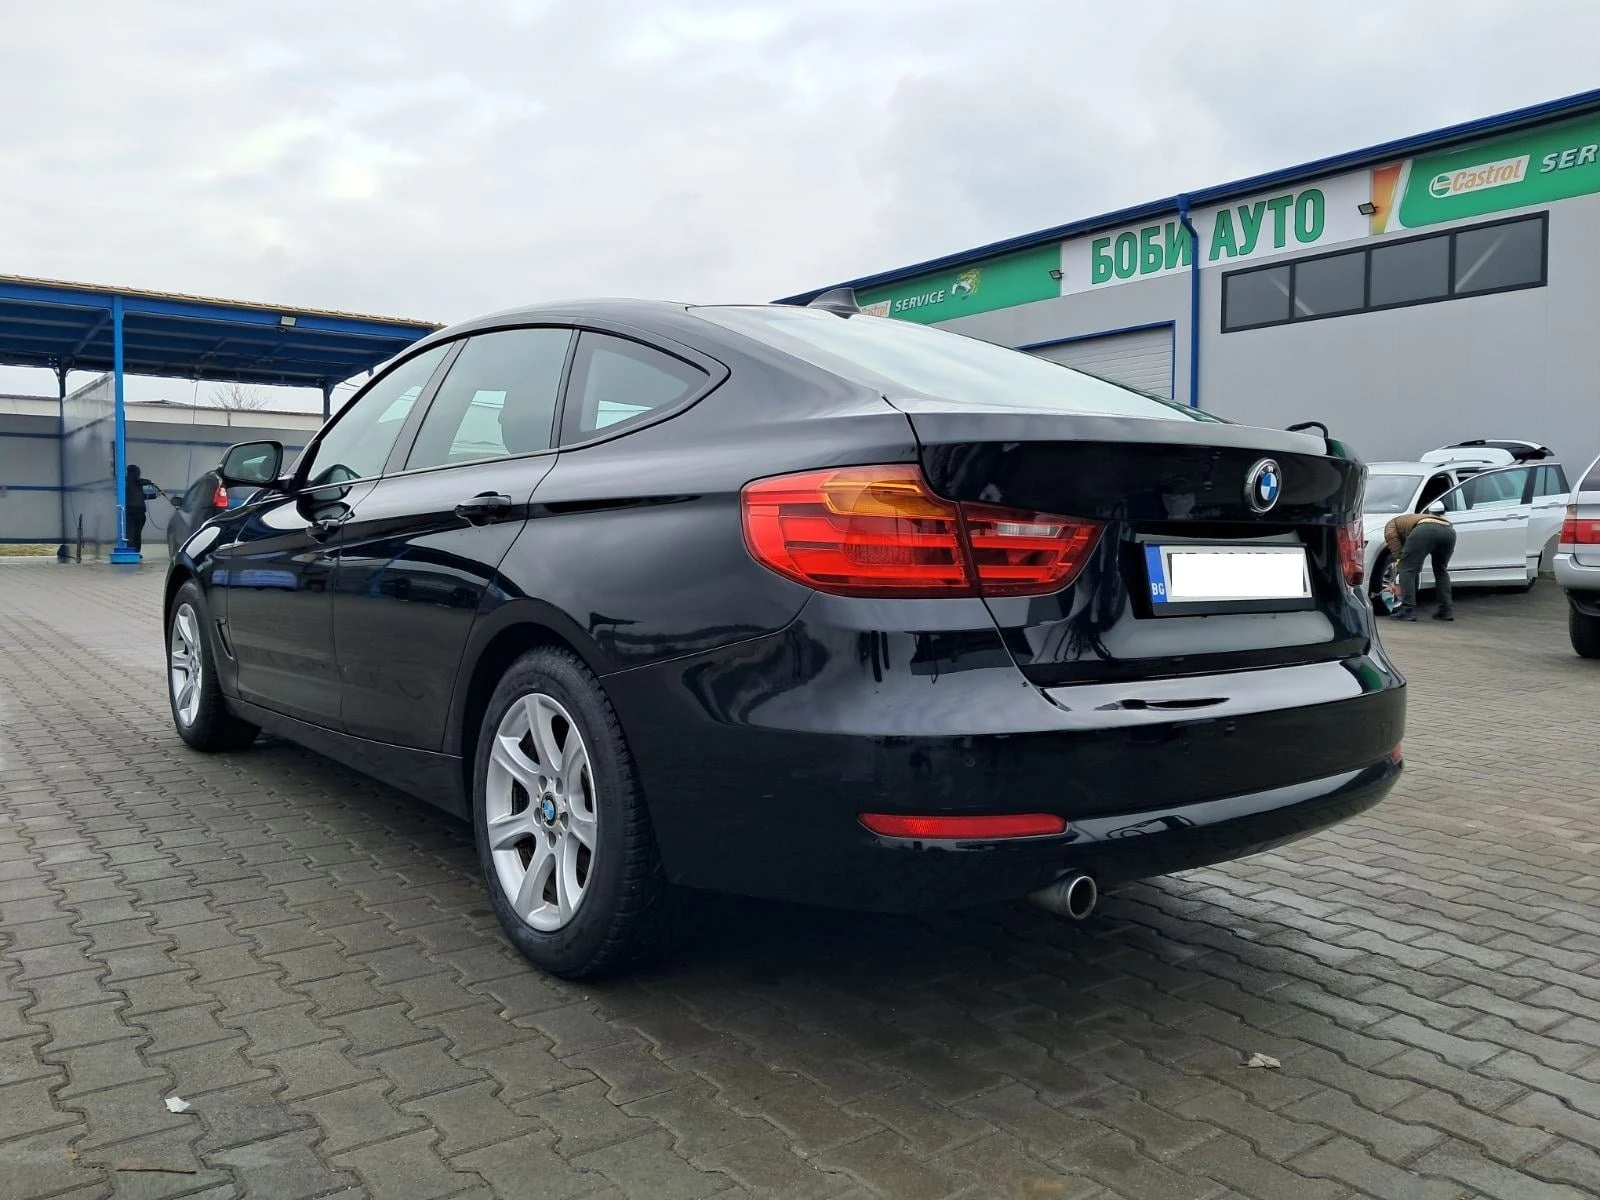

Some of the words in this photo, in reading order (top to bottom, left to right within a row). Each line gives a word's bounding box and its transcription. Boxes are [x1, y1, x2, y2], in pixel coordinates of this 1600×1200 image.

[1452, 160, 1523, 192] Castrol
[1091, 217, 1193, 285] БОБИ
[1208, 188, 1326, 261] АУТО
[895, 289, 945, 313] SERVICE
[1151, 582, 1165, 596] BG
